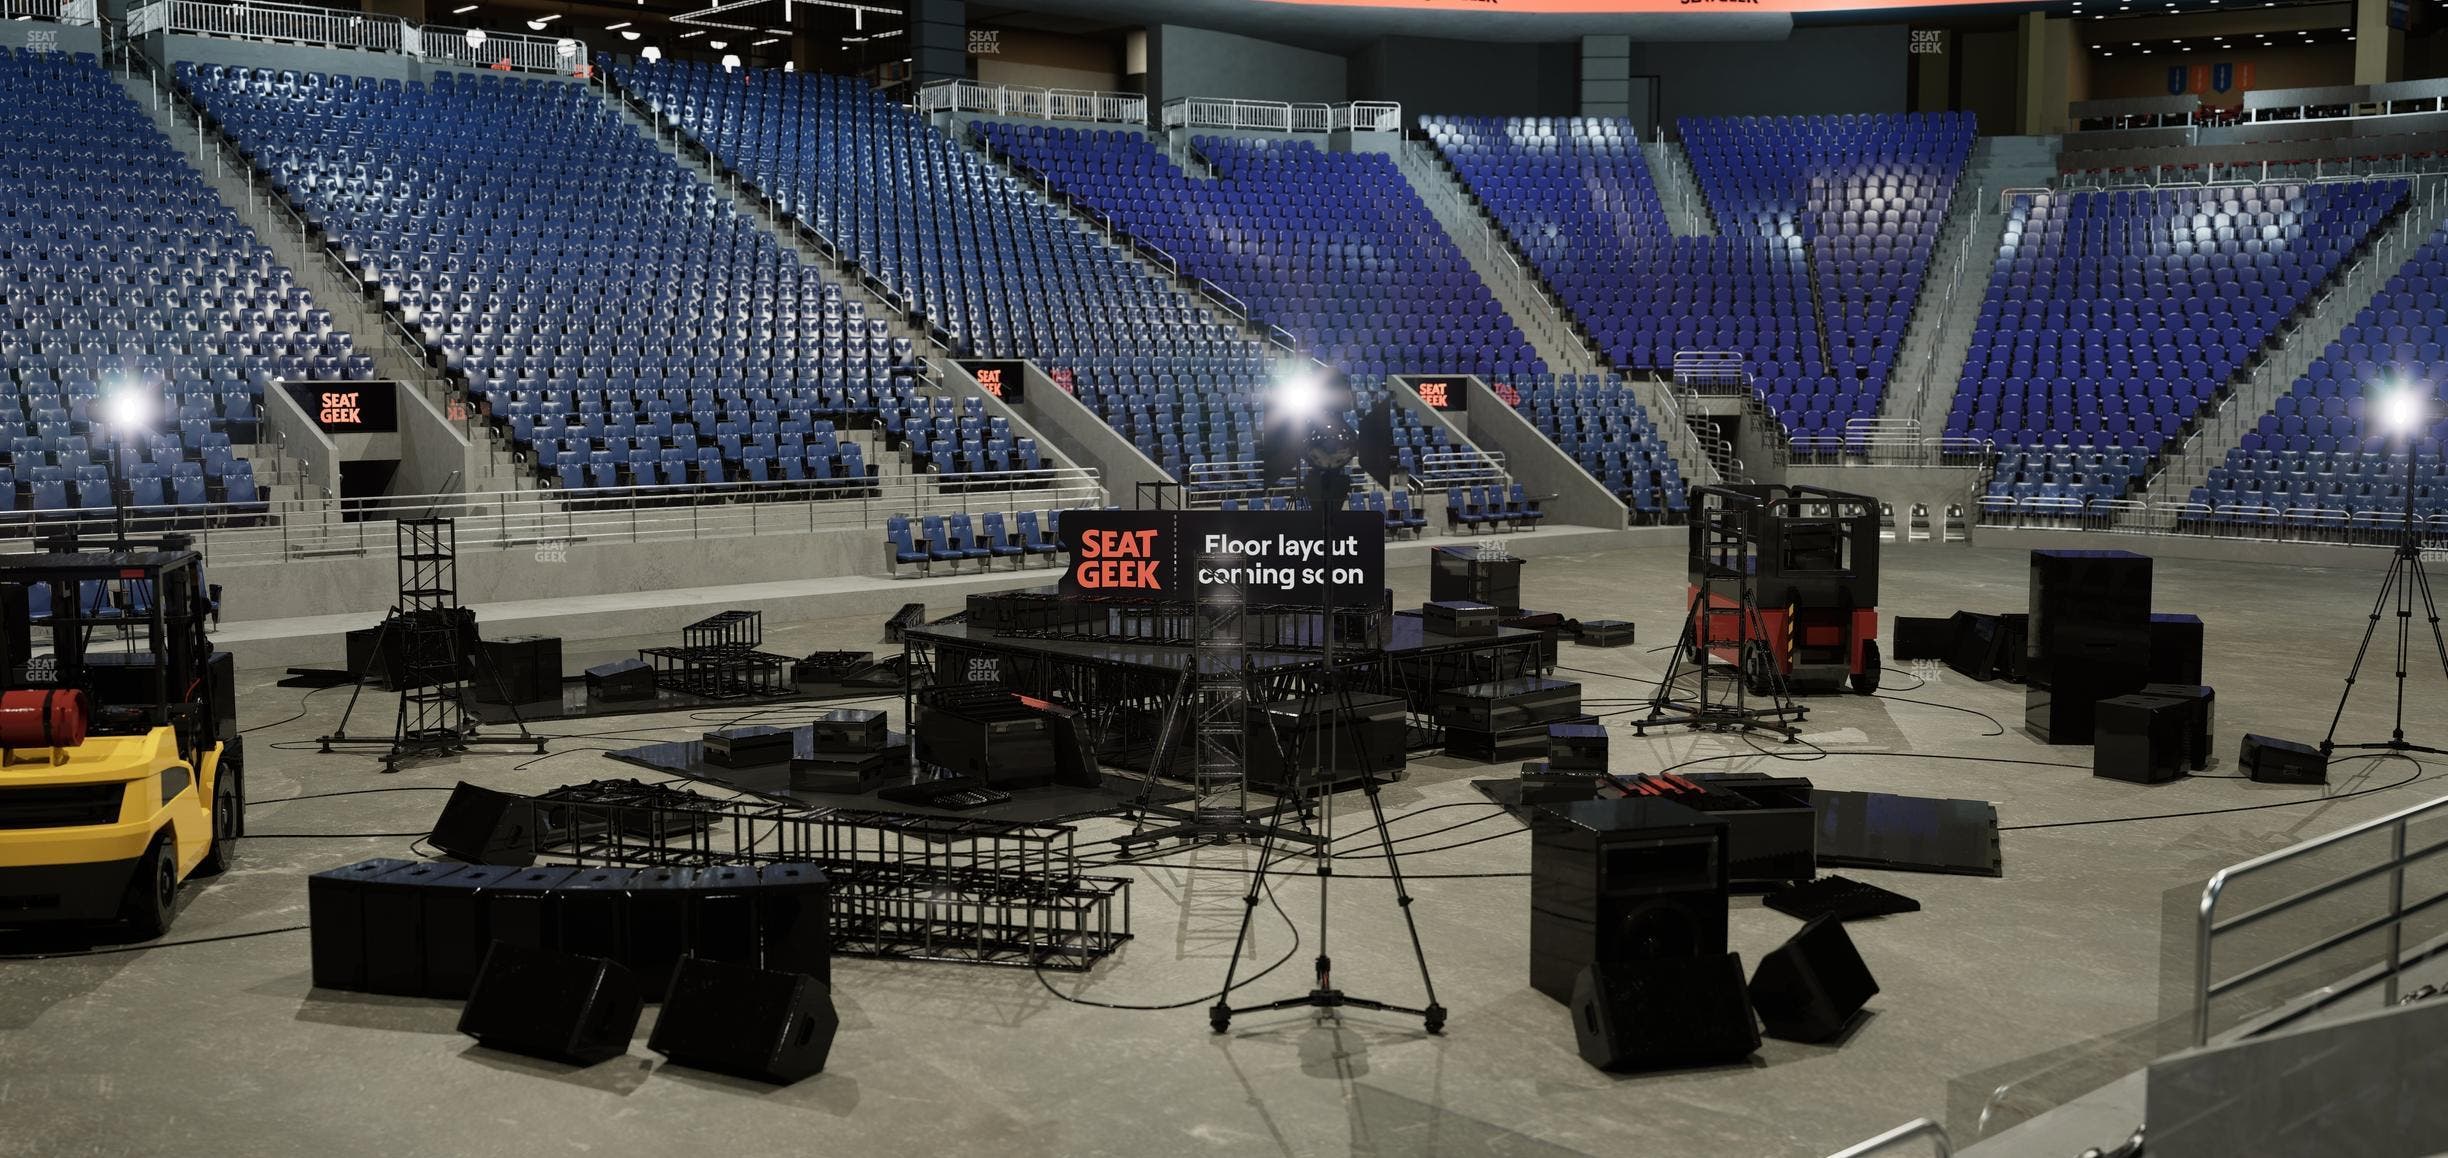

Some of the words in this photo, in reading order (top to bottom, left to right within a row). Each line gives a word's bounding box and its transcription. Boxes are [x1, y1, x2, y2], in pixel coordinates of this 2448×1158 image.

[977, 369, 1001, 382] SEAT
[321, 392, 359, 408] SEAT
[1419, 383, 1447, 395] SEAT
[320, 408, 361, 424] GEEK
[1081, 529, 1159, 558] SEAT
[1205, 533, 1272, 556] Floor
[1278, 533, 1358, 562] layout
[1077, 560, 1161, 590] GEEK
[1198, 562, 1295, 590] coming
[1301, 567, 1364, 584] soon
